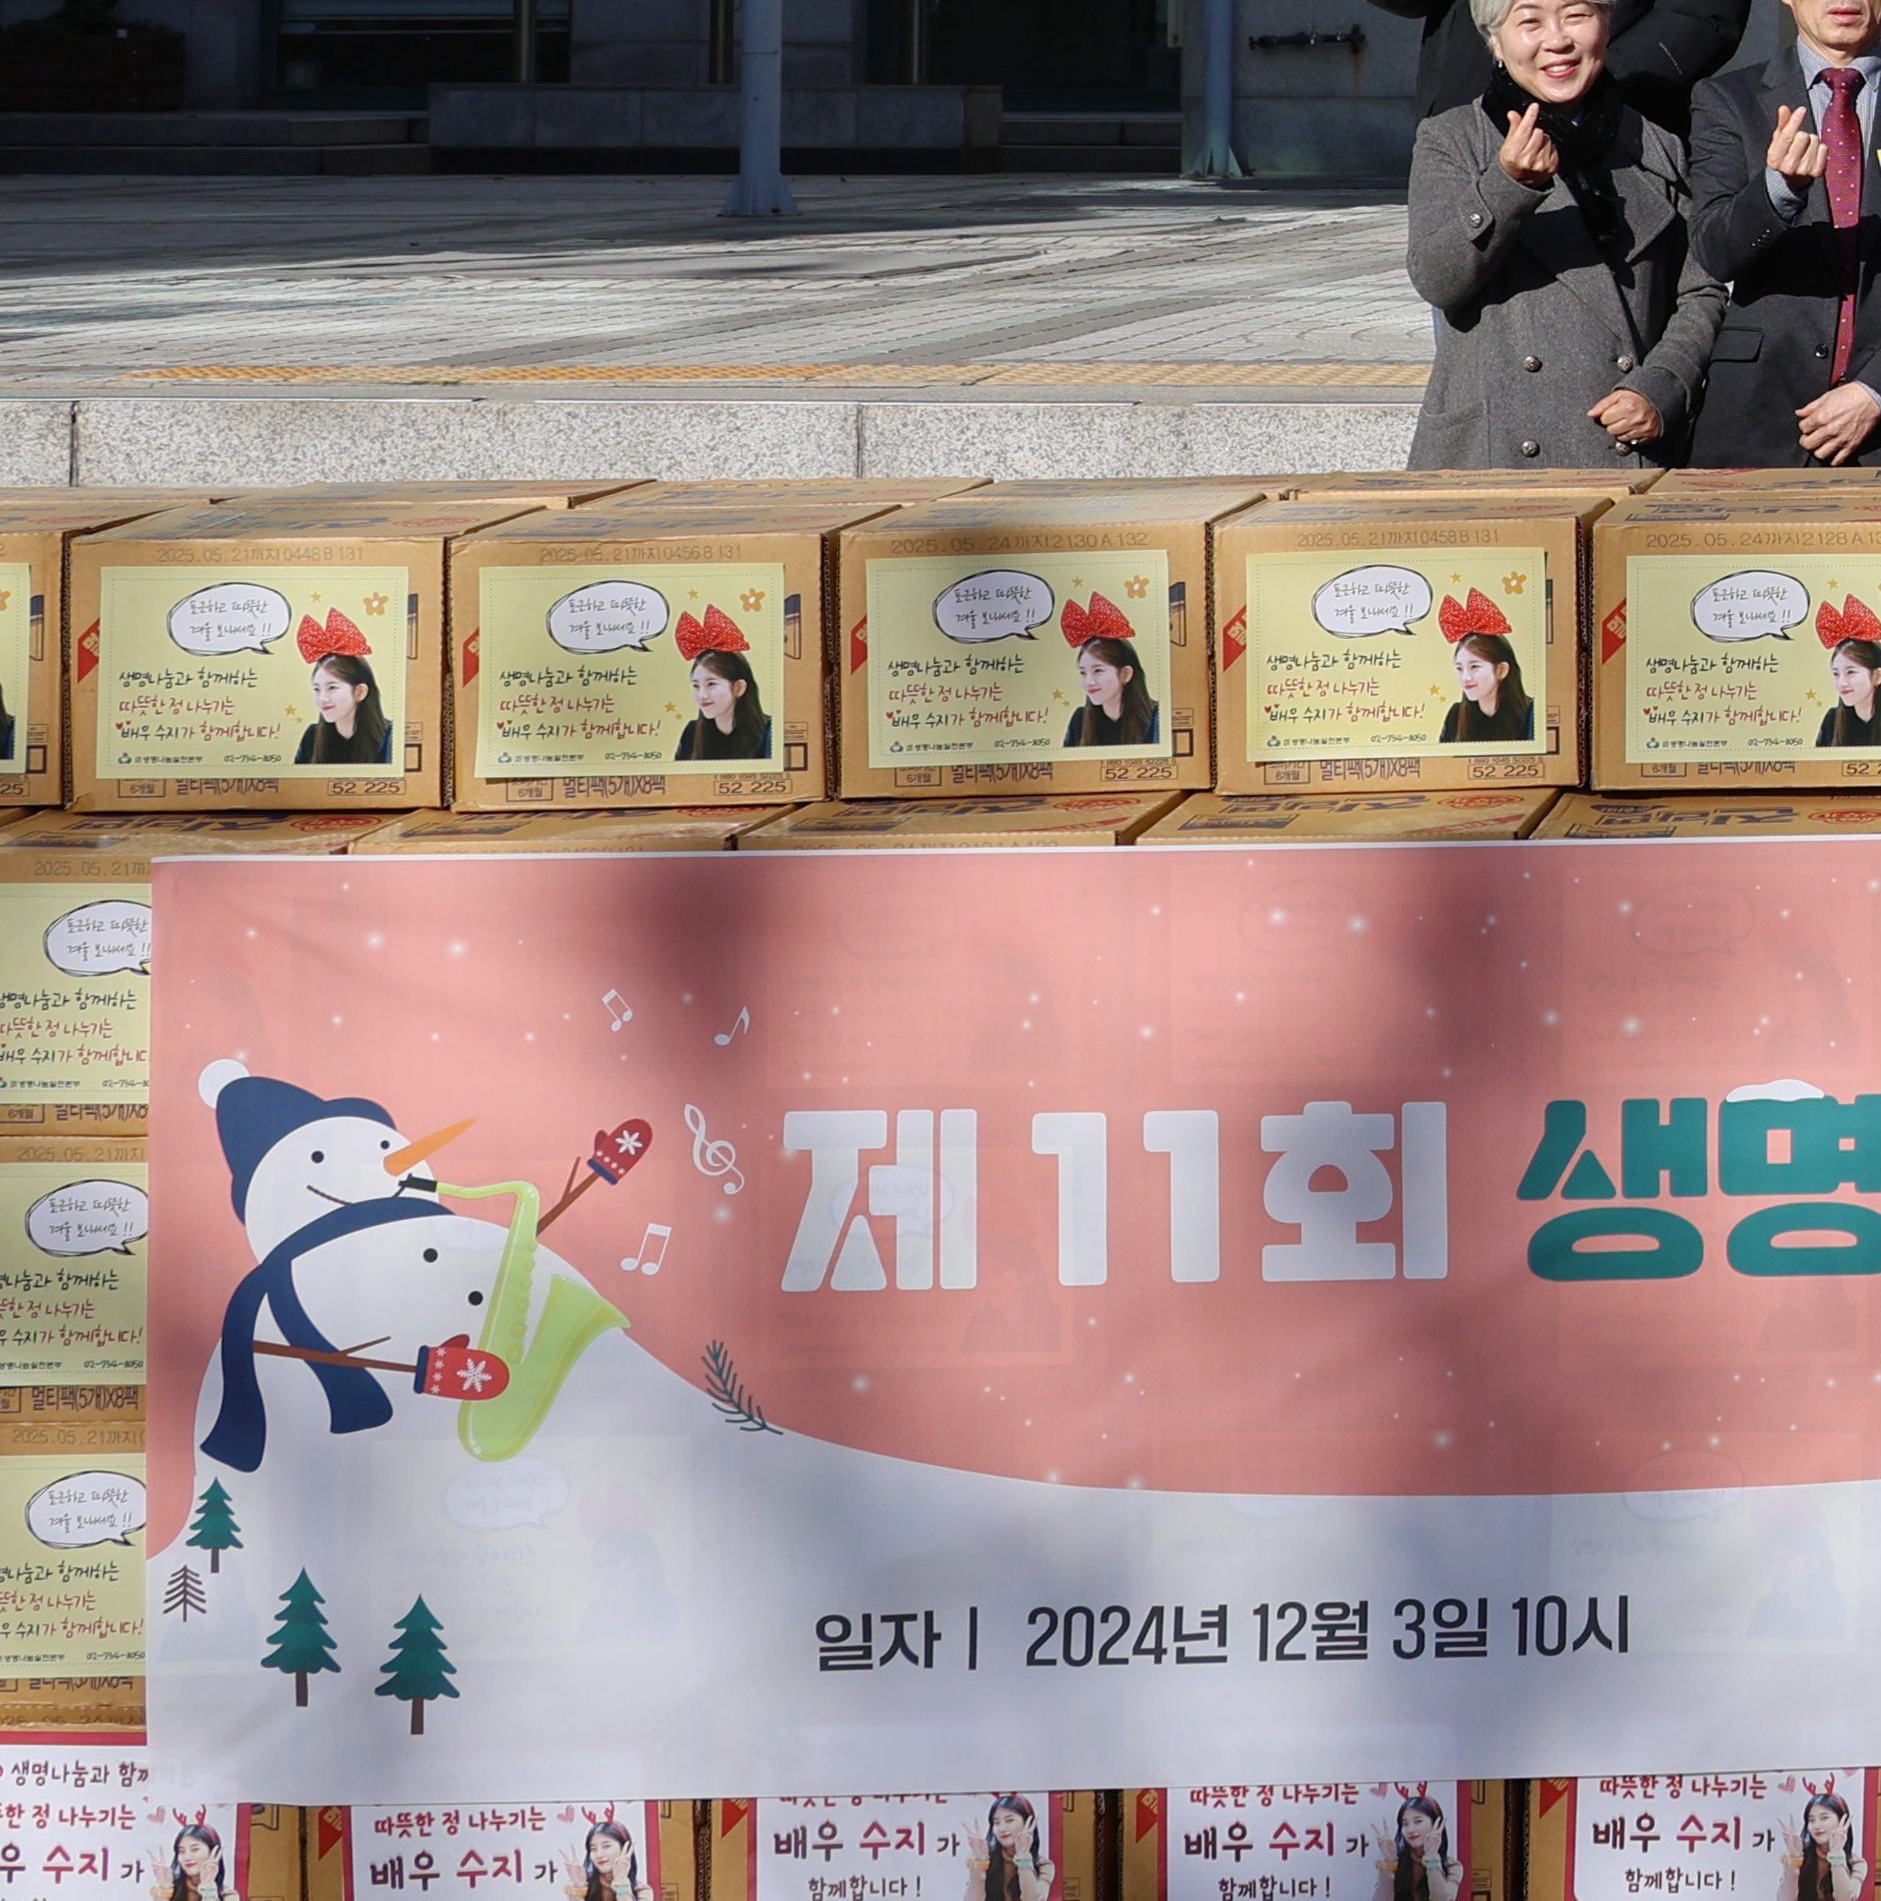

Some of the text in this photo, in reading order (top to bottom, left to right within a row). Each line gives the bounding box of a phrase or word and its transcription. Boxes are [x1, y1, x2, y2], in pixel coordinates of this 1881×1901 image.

[888, 654, 1024, 677] 생명나눔과 함께하는
[889, 682, 1002, 704] 따뜻한 정 나누기는
[891, 714, 921, 729] 배우
[969, 707, 1048, 727] 함께합니다!
[1105, 765, 1174, 780] 52 225
[1846, 761, 1871, 774] 52
[331, 781, 401, 795] 52 225
[815, 1594, 1629, 1672] 일자 2024년 12월 3일 10시
